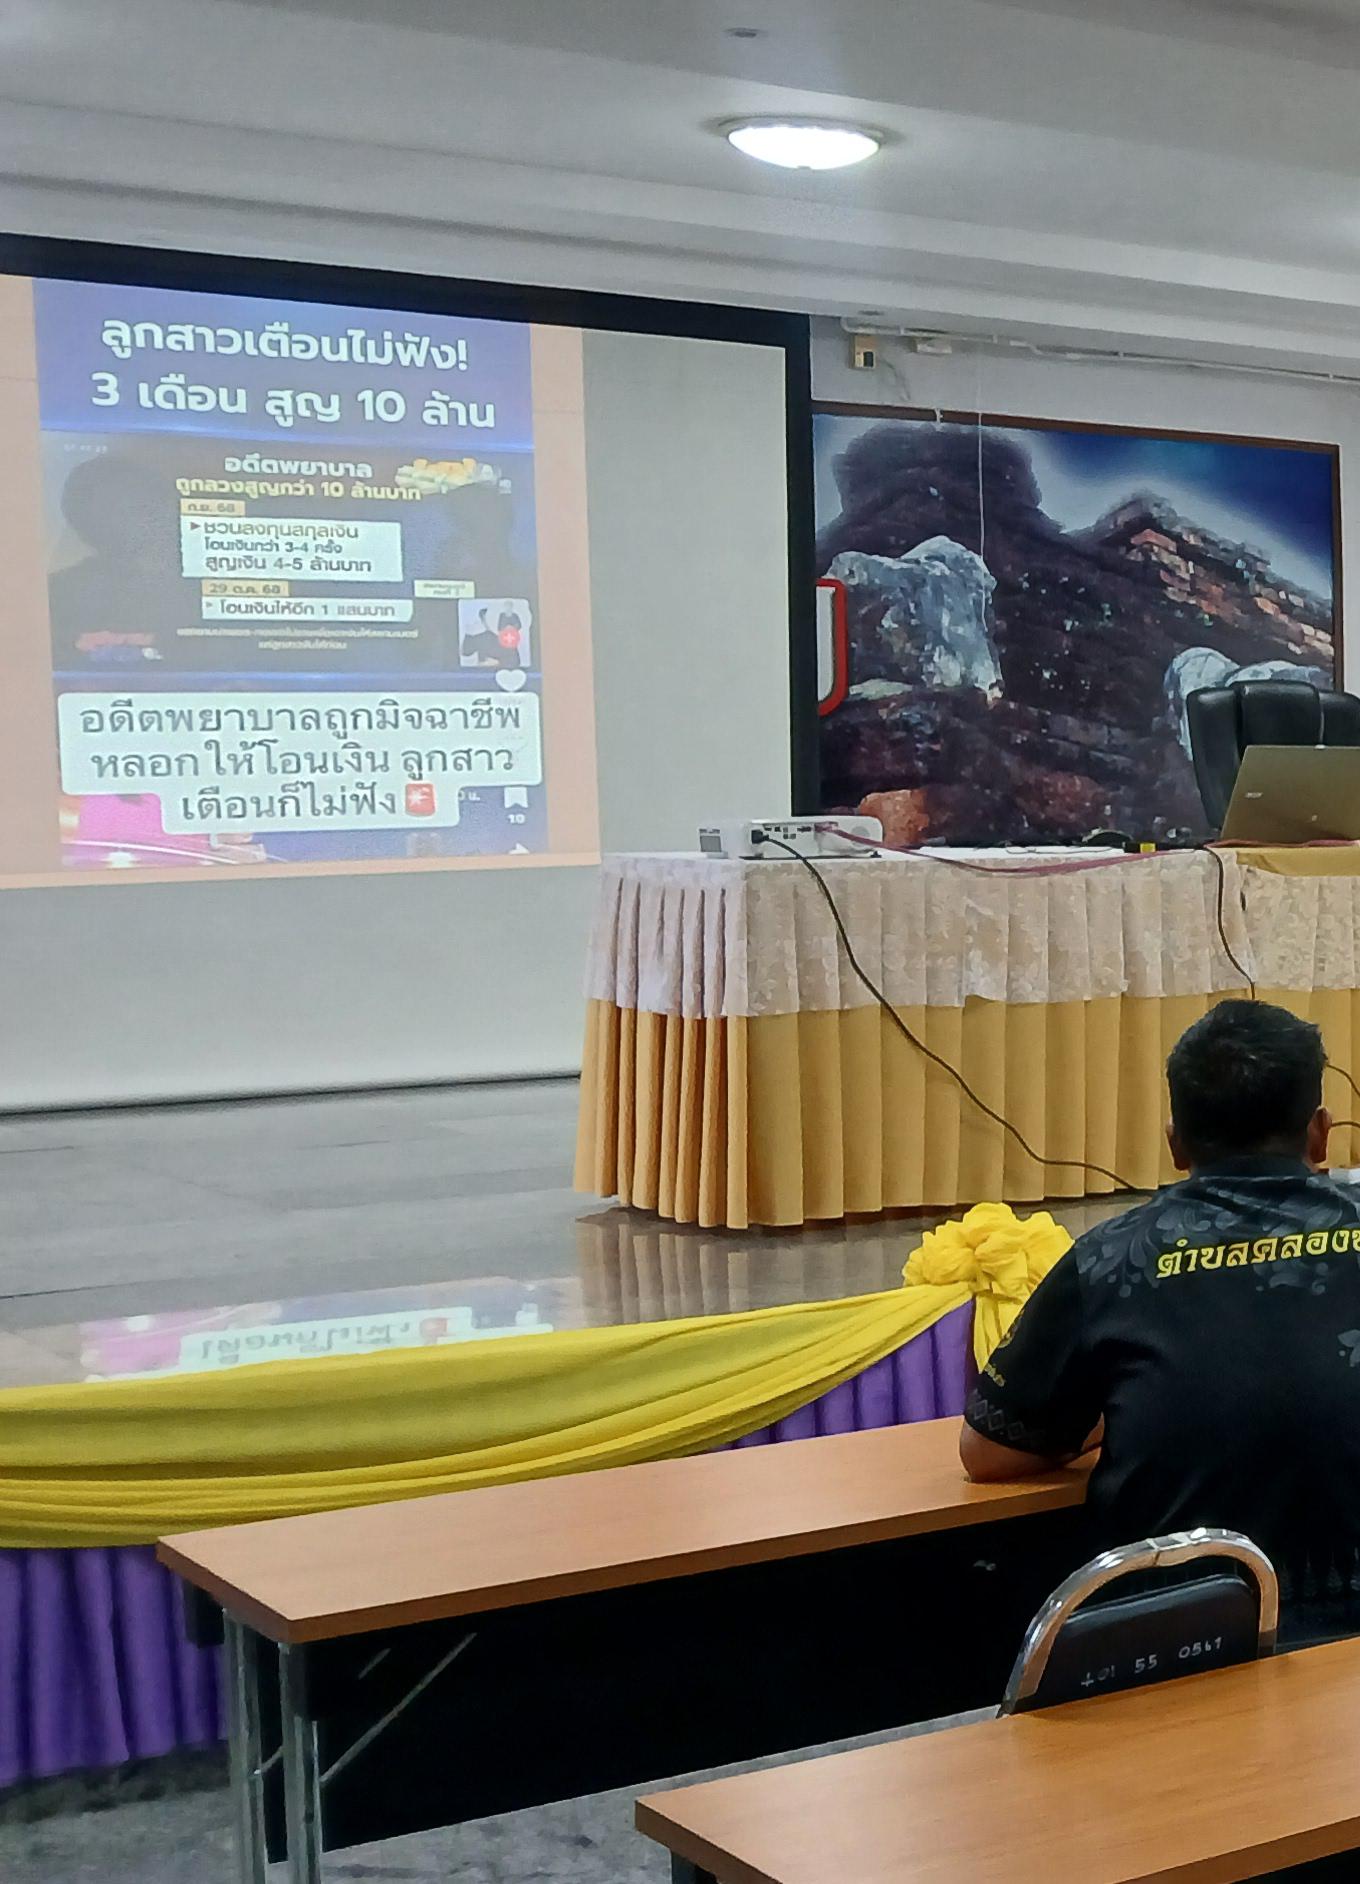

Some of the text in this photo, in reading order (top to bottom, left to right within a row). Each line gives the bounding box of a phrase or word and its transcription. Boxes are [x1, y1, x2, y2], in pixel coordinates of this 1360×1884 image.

[101, 319, 468, 372] ลูกสาวเตือนไม่ฟัง!
[91, 371, 496, 429] 3 เดือน สูญ 10 ล้าน
[224, 452, 373, 478] อดีตพยาบาล
[320, 480, 345, 498] 10
[350, 480, 422, 501] ล้านบาท
[204, 536, 280, 552] โอนเงินกว่า
[284, 540, 309, 553] 3-4
[205, 555, 373, 573] สูญเงิน 4-5 ล้านบาท
[320, 604, 329, 615] 1
[79, 698, 521, 740] อดีตพยาบาลถูกมิจฉาชีพ
[400, 747, 515, 781] ลูกสาว
[180, 780, 397, 821] เตือนก็ไม่ฟัง
[1133, 1654, 1158, 1674] 55
